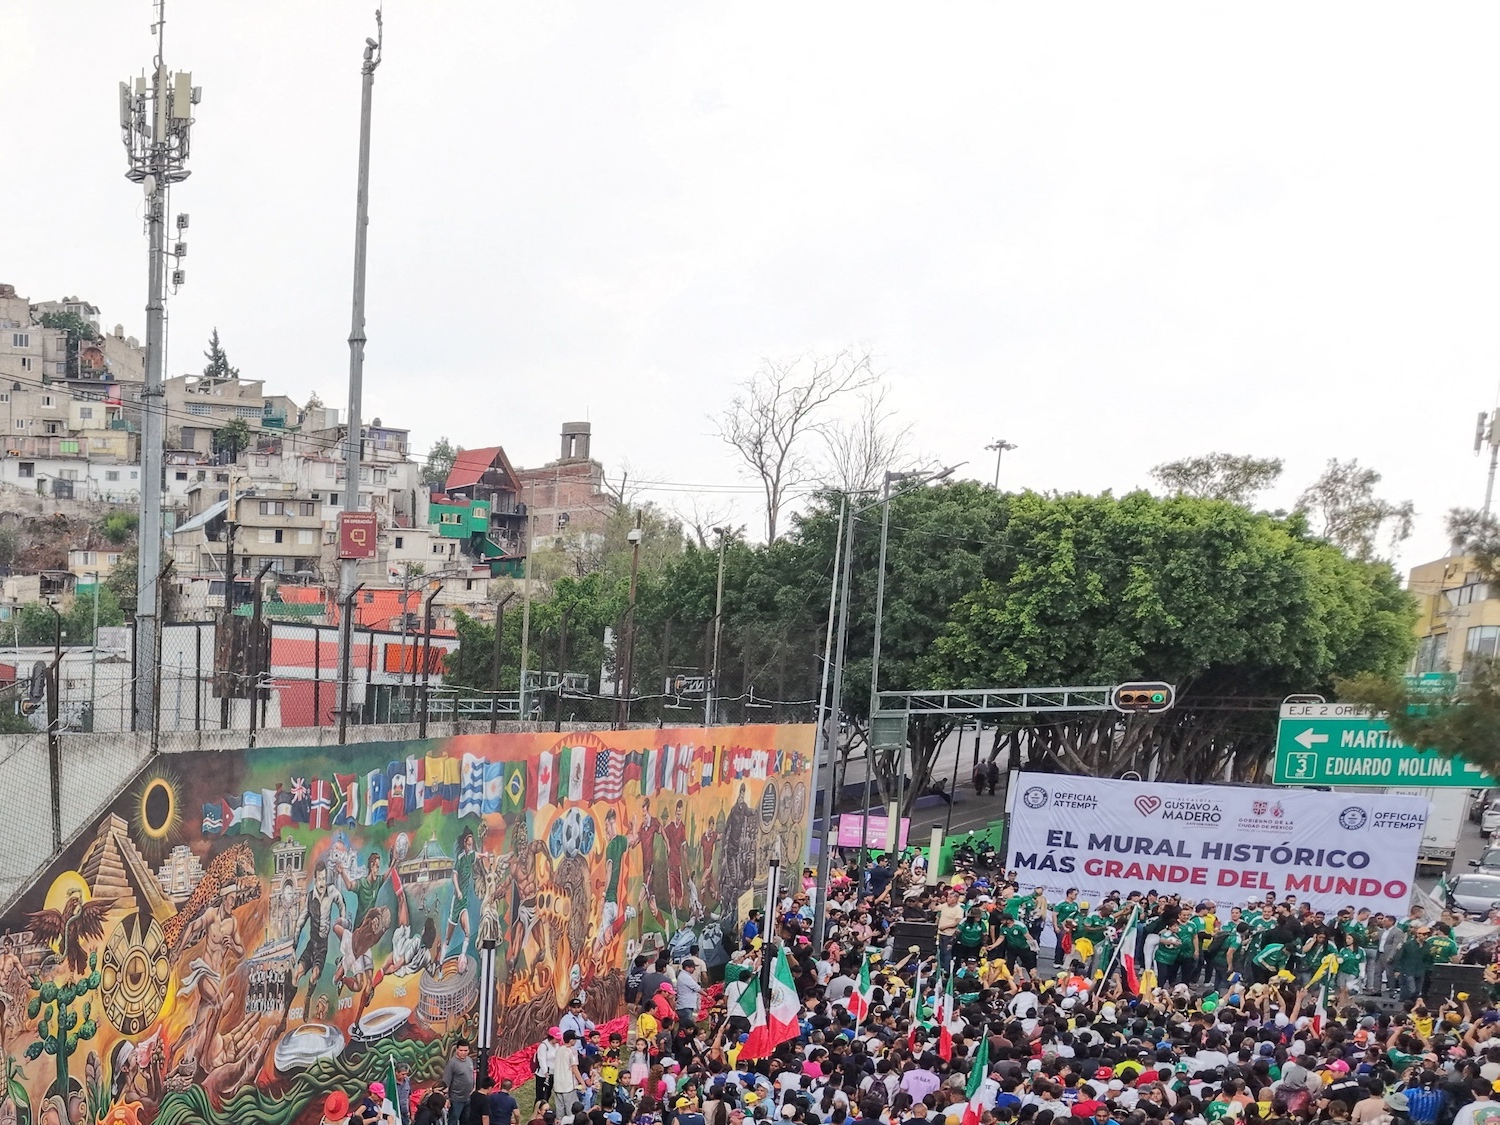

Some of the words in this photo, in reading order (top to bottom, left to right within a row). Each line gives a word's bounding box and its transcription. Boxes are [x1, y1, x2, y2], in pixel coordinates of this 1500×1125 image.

[1289, 706, 1313, 716] EJE
[1320, 706, 1329, 716] 2
[1296, 759, 1308, 774] 3
[1325, 758, 1392, 776] EDUARDO
[1398, 759, 1452, 777] MOLINA
[1054, 792, 1099, 802] OFFICIAL
[1053, 801, 1098, 811] ATTEMPT
[1164, 801, 1211, 811] GUSTAVO
[1212, 804, 1222, 812] A.
[1162, 810, 1221, 822] MADERO
[1374, 812, 1425, 822] OFFICIAL
[1373, 821, 1425, 831] ATTEMPT
[1046, 830, 1079, 849] EL
[1087, 833, 1192, 858] MURAL
[1201, 841, 1370, 869] HISTÓRICO
[1014, 850, 1076, 873] MÁS
[1084, 858, 1209, 885] GRANDE
[1217, 869, 1276, 890] DEL
[1285, 873, 1408, 899] MUNDO
[393, 986, 407, 998] 1986
[337, 997, 353, 1009] 1970
[288, 1008, 303, 1020] 1892
